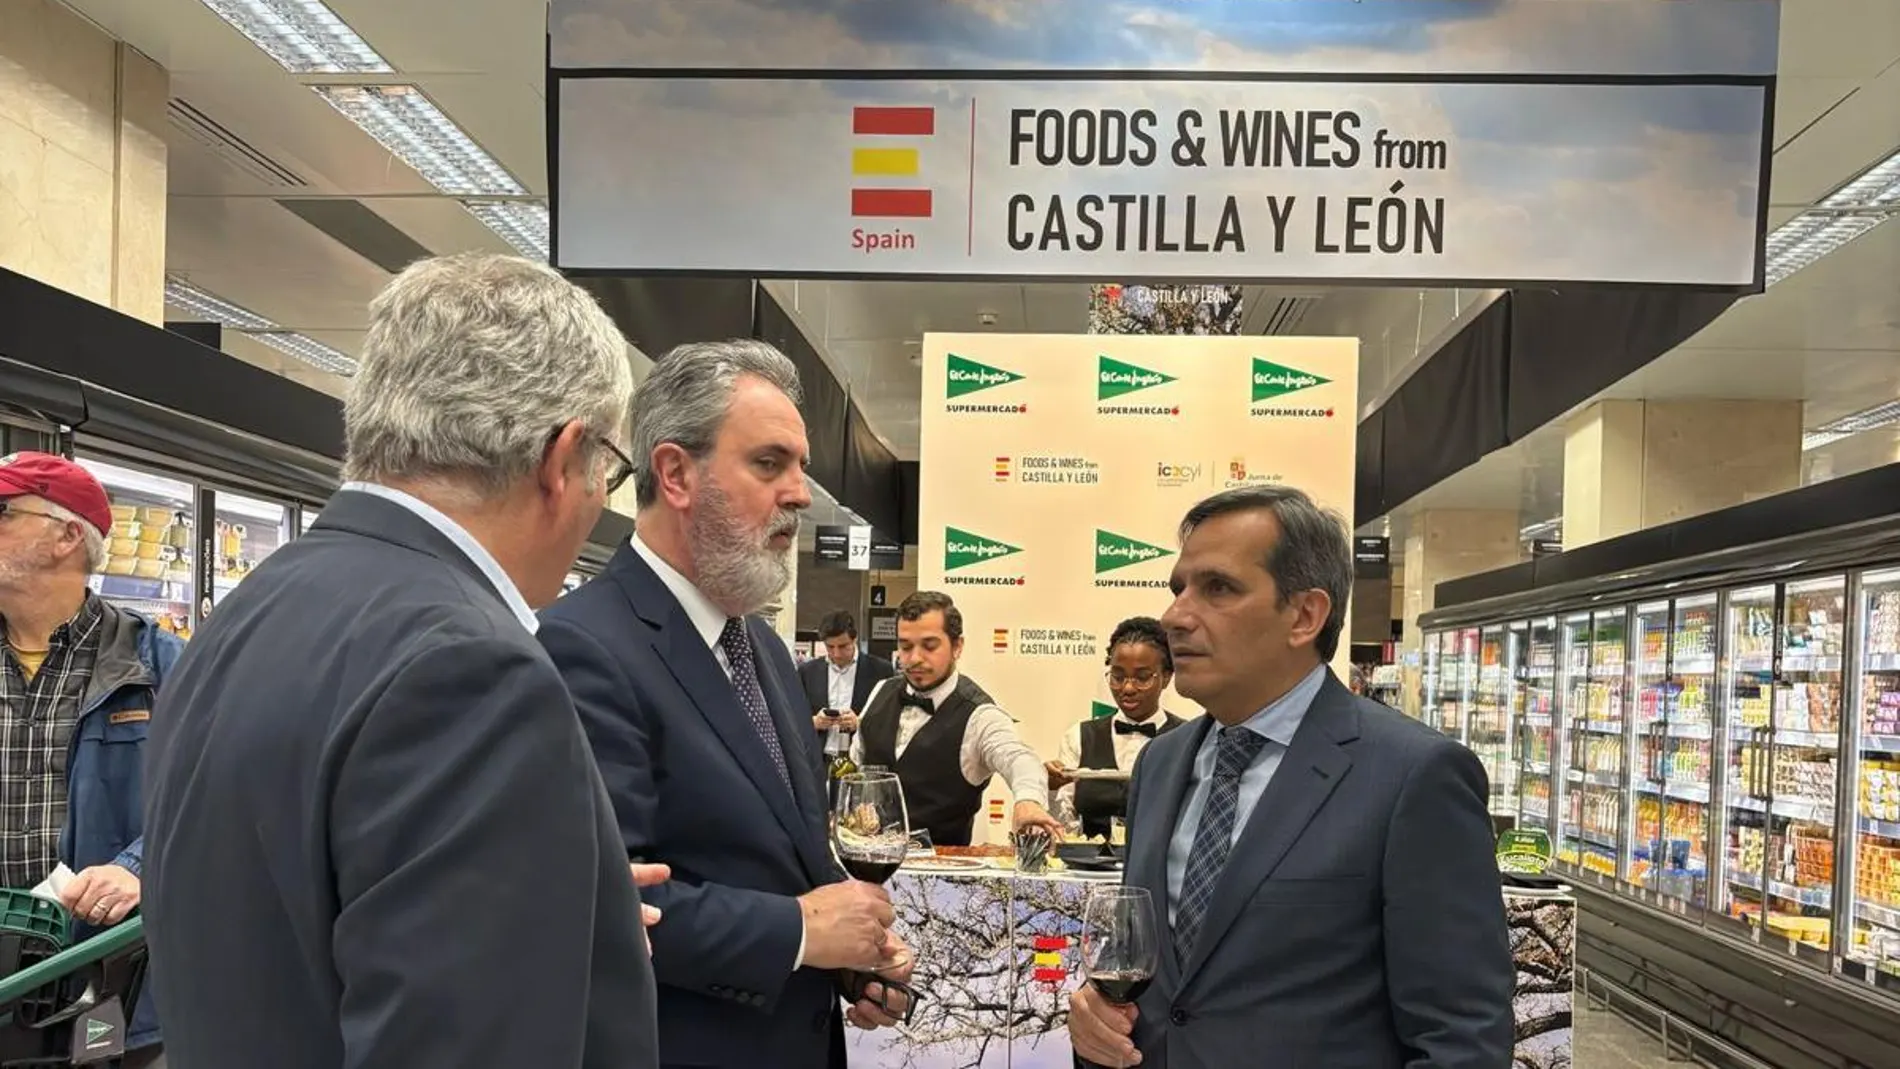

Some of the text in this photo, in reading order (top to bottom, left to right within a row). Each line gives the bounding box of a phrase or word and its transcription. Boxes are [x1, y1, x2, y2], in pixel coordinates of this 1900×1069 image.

[1010, 108, 1447, 169] FOODS & WINES from
[1008, 179, 1444, 253] CASTILLA Y LEÓN
[851, 228, 914, 253] Spain
[1138, 289, 1187, 303] CASTILLA
[1190, 289, 1199, 303] Y
[946, 404, 1027, 413] SUPERMERCADO
[1097, 405, 1179, 415] SUPERMERCADO
[1251, 407, 1334, 417] SUPERMERCADO
[1022, 457, 1049, 468] FOODS
[1059, 457, 1084, 468] WINES
[1022, 470, 1098, 483] CASTILLA Y LEÓN
[851, 545, 868, 557] 37
[944, 575, 1025, 585] SUPERMERCADO
[1095, 580, 1171, 588] SUPERMERCAD
[874, 592, 882, 604] 4
[1020, 629, 1047, 640] FOODS
[1049, 630, 1056, 640] &
[1057, 630, 1081, 641] WINES
[1020, 641, 1096, 656] CASTILLA Y LEÓN
